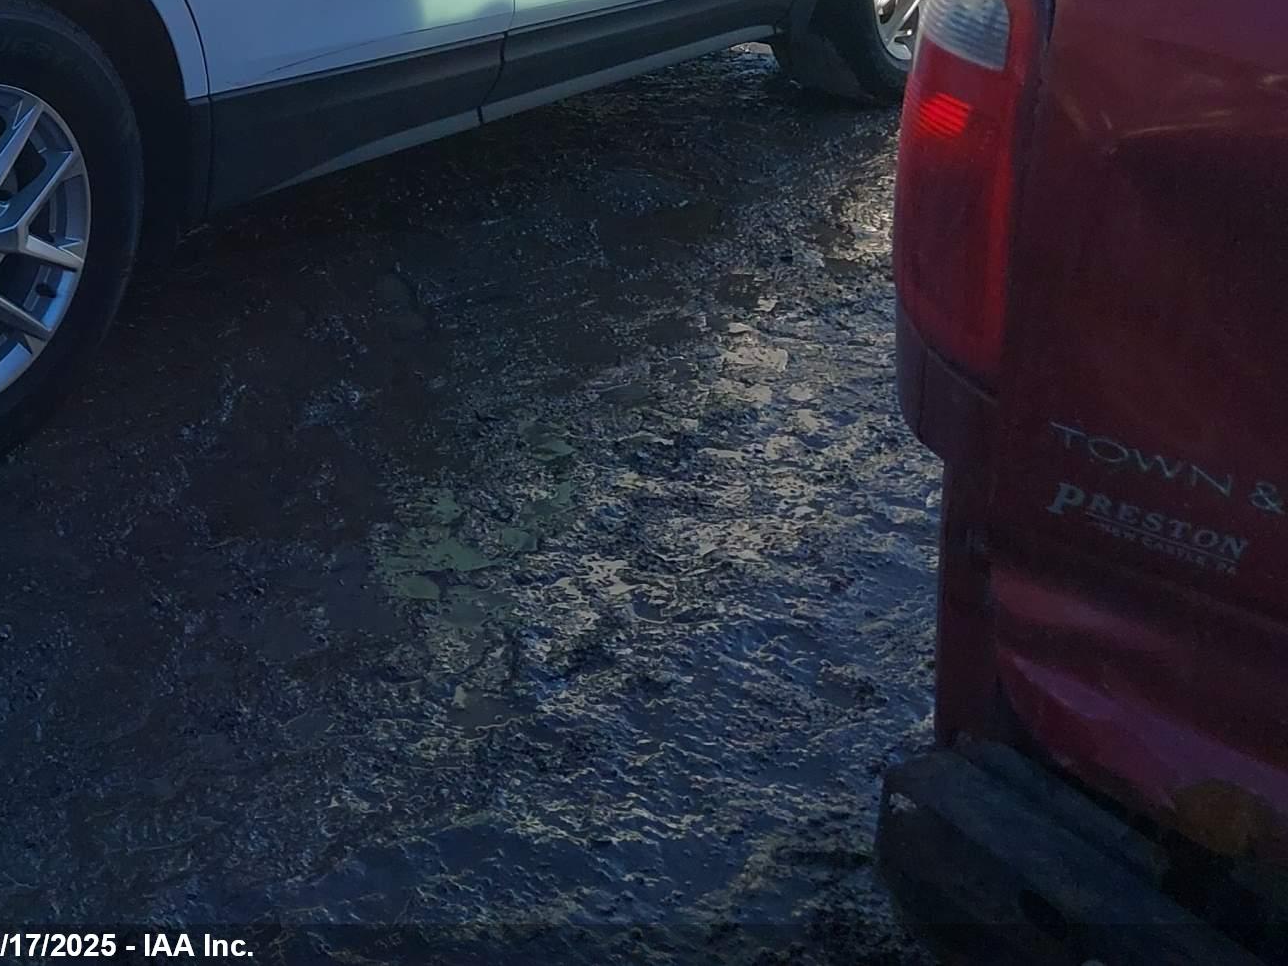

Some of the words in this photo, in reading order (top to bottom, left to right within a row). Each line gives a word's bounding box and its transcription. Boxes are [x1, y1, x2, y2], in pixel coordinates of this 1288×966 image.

[1050, 421, 1234, 498] TOWN
[1247, 480, 1286, 515] &
[1046, 482, 1249, 559] PRESTON
